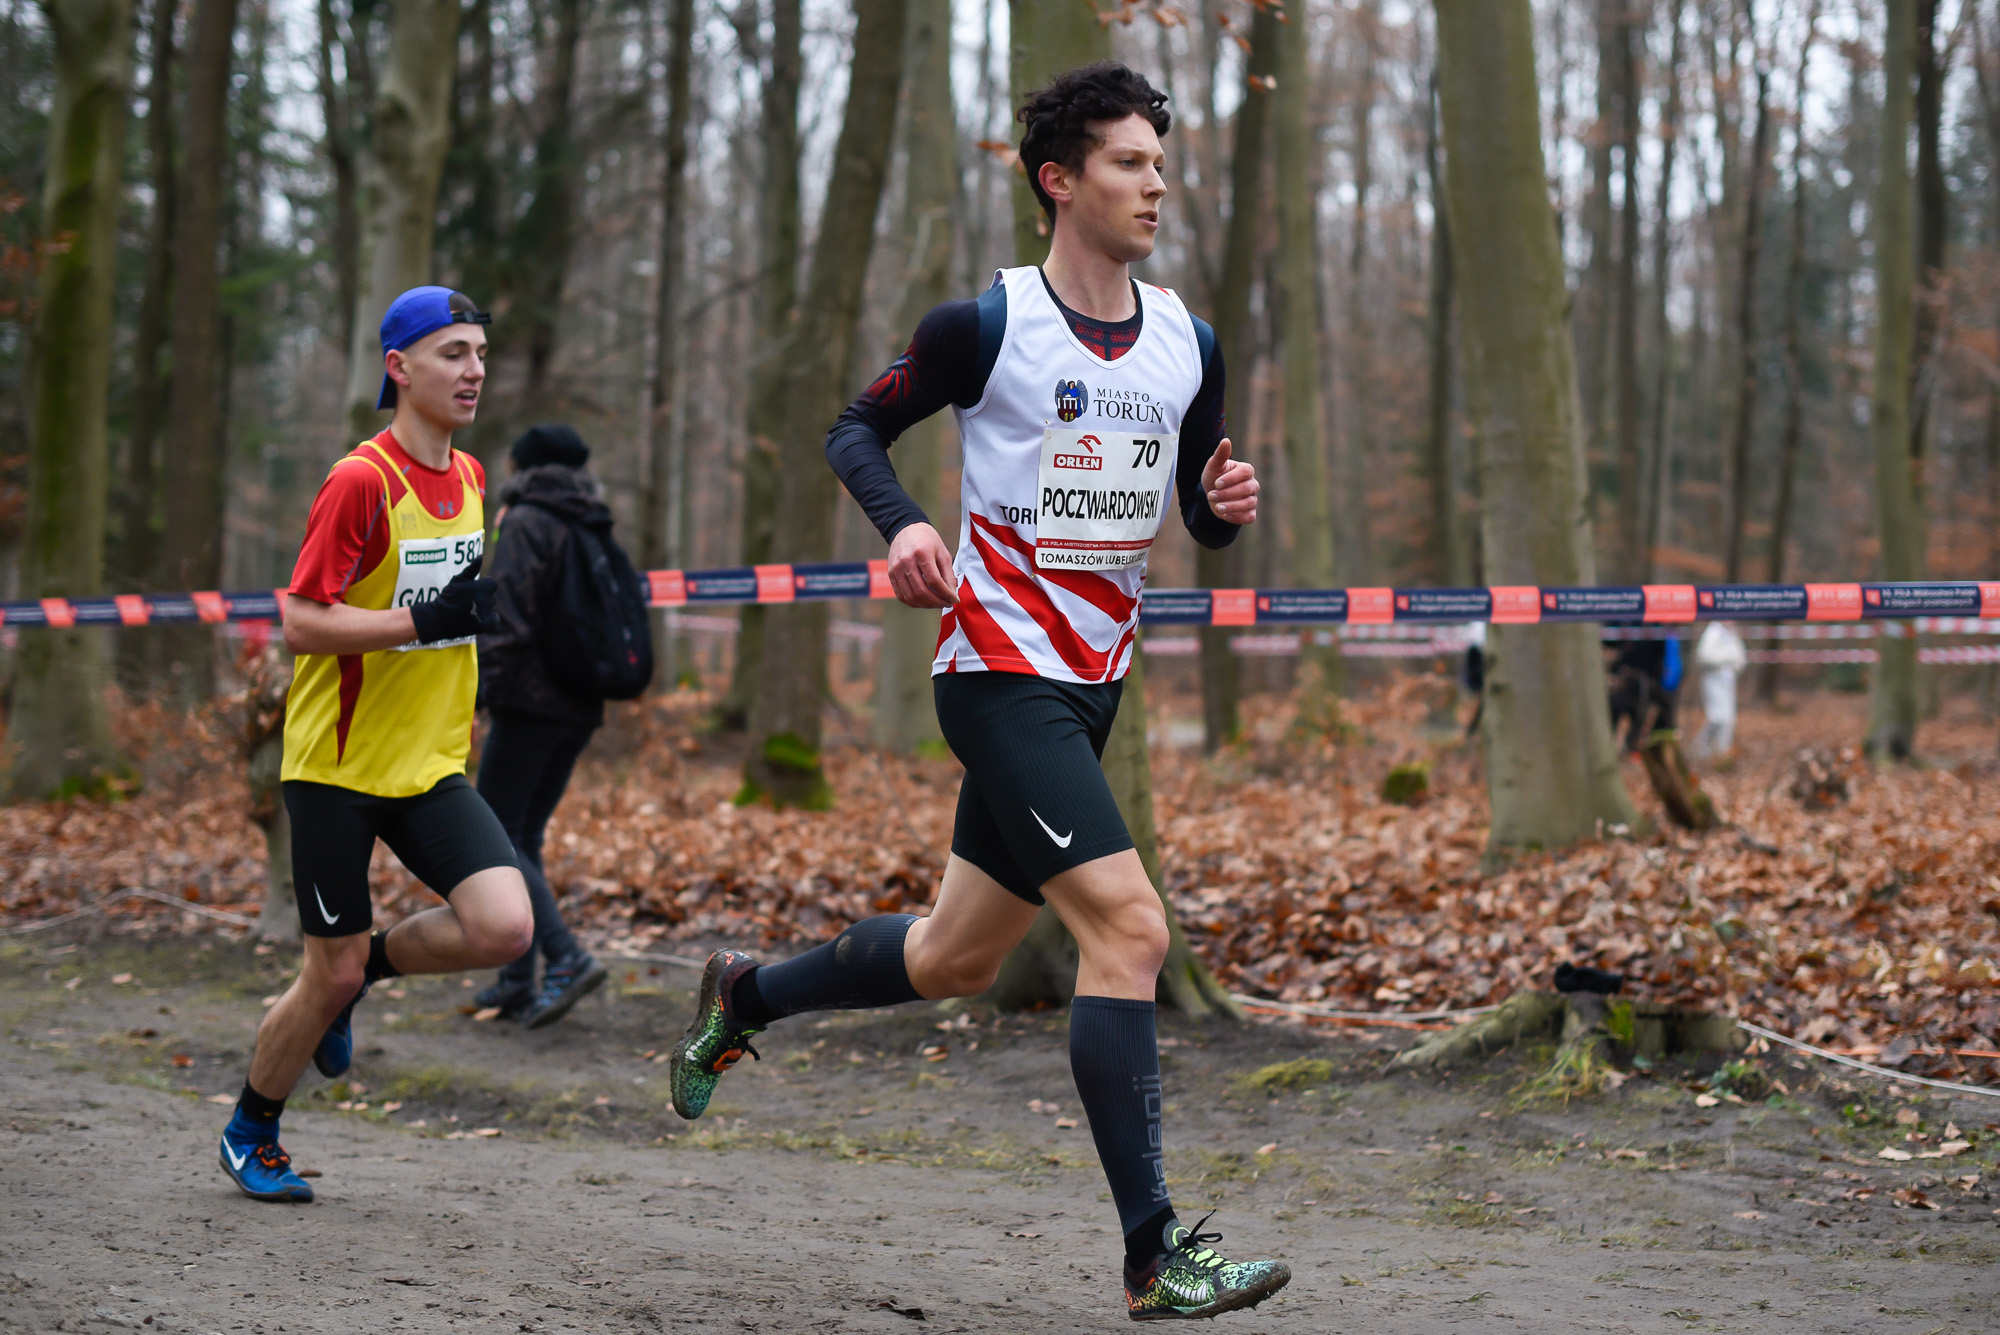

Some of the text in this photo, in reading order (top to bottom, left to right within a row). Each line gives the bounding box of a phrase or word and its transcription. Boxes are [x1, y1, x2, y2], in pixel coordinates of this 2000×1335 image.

[1096, 388, 1150, 403] MIASTO
[1093, 399, 1164, 424] TORUŃ
[1055, 455, 1101, 469] ORLEN
[1131, 439, 1161, 468] 70
[1042, 487, 1160, 520] POCZWARDOWSKI
[999, 505, 1037, 525] TOR
[1041, 552, 1104, 566] TOMASZÓW
[1132, 1074, 1169, 1202] kalenji
